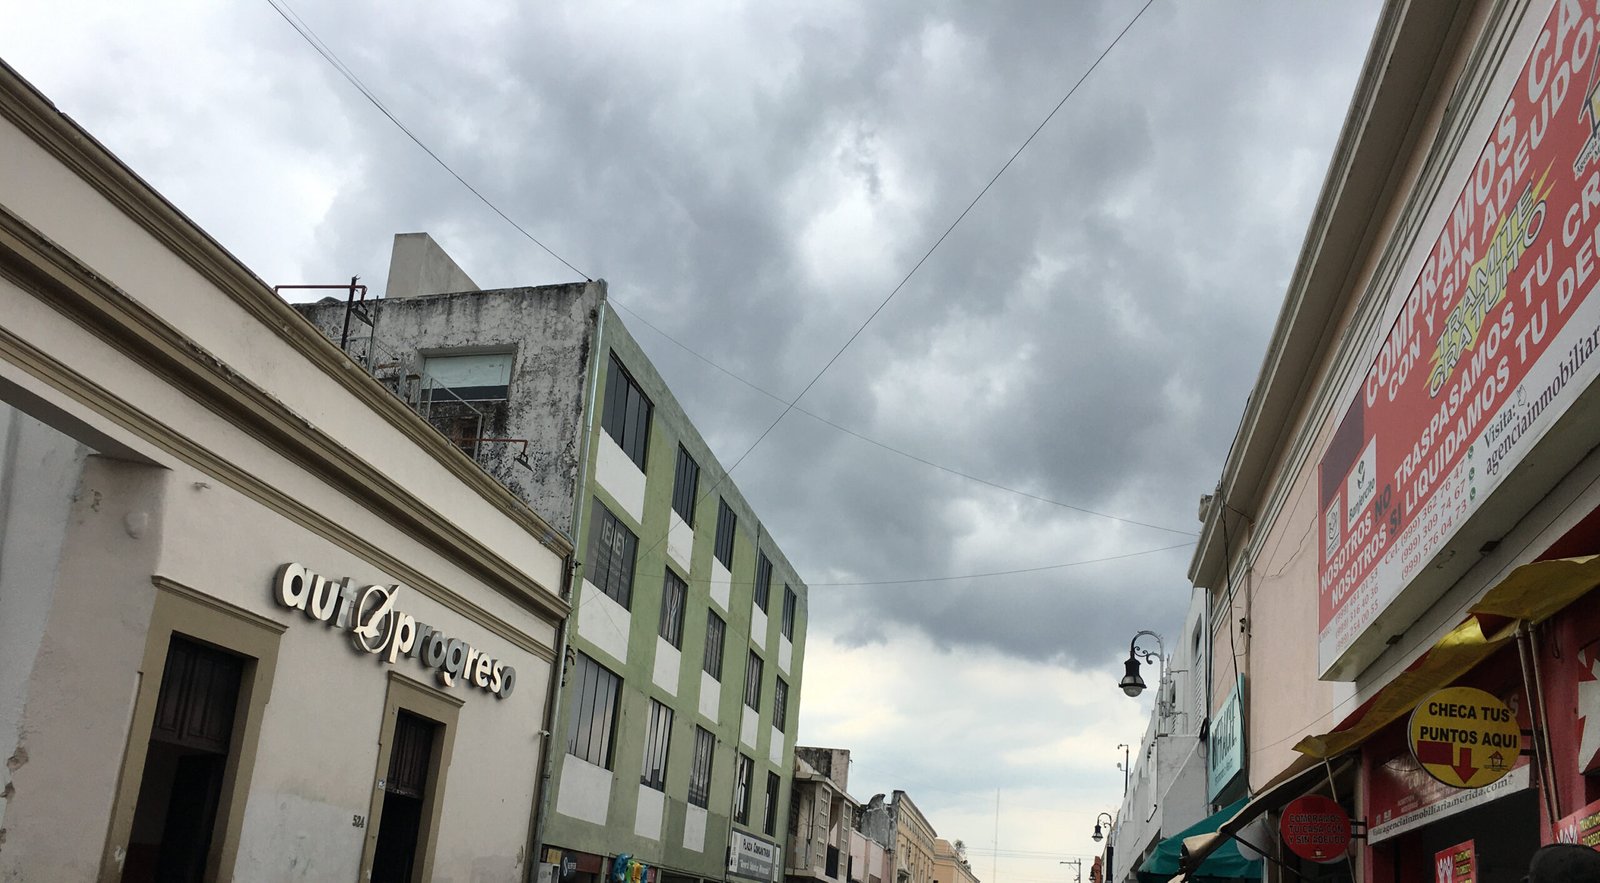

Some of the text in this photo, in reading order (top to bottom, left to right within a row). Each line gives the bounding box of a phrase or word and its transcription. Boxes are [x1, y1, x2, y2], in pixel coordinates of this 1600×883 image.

[1366, 0, 1600, 408] COMPRAMOS CA
[1388, 329, 1420, 402] CON
[1425, 300, 1438, 337] Y
[1442, 231, 1475, 310] SIN
[1482, 16, 1600, 244] ADEUDO
[1436, 180, 1534, 358] TRAMITE
[1429, 199, 1547, 399] GRATUITO
[1321, 511, 1371, 595] NOSOTROS
[1375, 483, 1392, 524] NO
[1395, 301, 1515, 493] TRASPASAMOS
[1520, 239, 1553, 307] TU
[1332, 522, 1386, 609] NOSOTROS
[1390, 501, 1402, 535] SI
[1406, 355, 1509, 516] LIQUIDAMOS
[1515, 299, 1548, 364] TU
[1484, 404, 1516, 449] Visita:
[1401, 516, 1420, 548] (999)
[1422, 496, 1437, 521] 362
[1441, 477, 1451, 498] 76
[1401, 478, 1466, 563] (999) 309 74 67
[1402, 499, 1467, 581] (999) 576 04 73
[1420, 726, 1518, 749] PUNTOS AQUI
[1429, 702, 1511, 723] CHECA TUS
